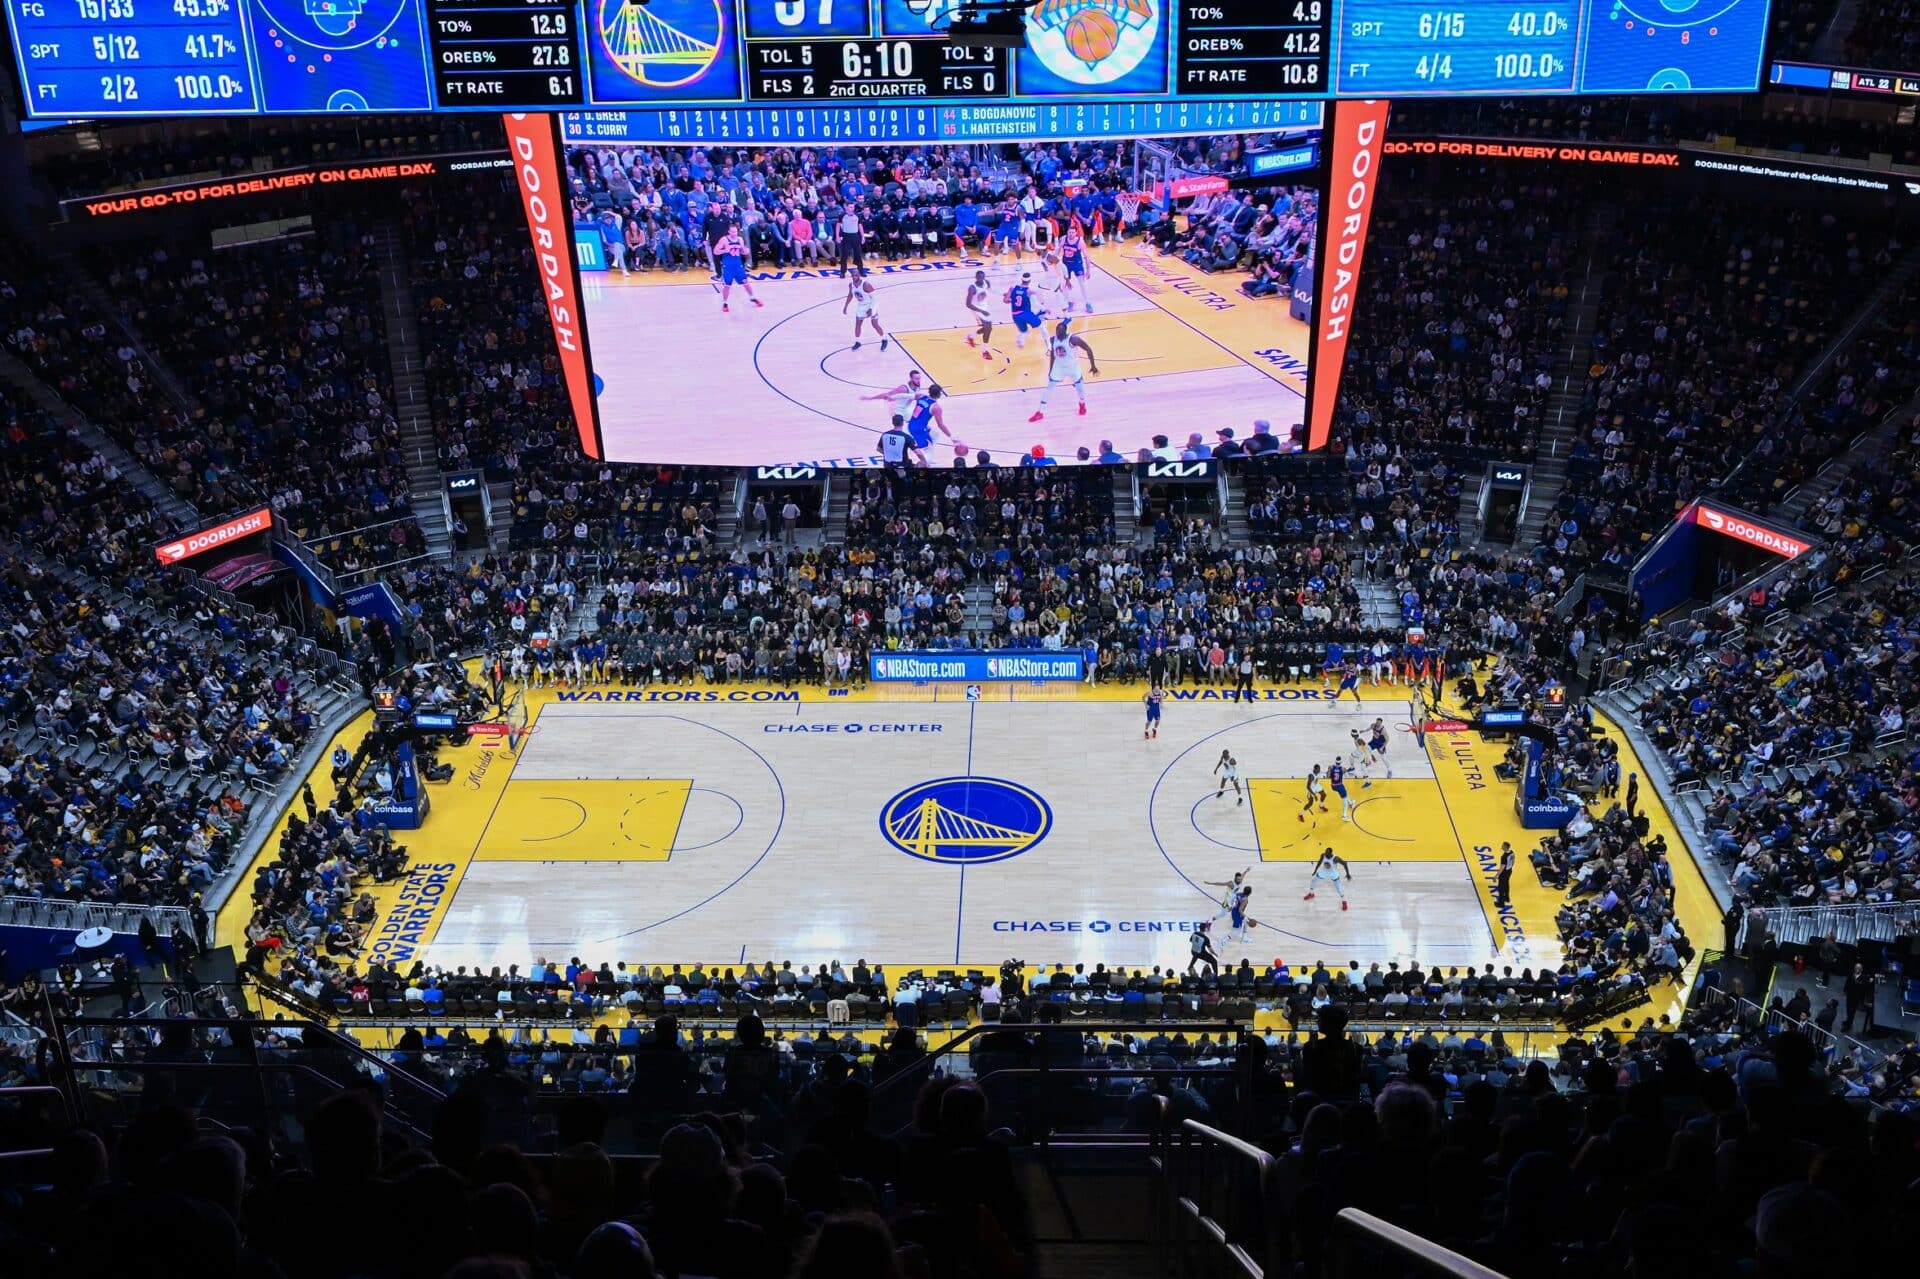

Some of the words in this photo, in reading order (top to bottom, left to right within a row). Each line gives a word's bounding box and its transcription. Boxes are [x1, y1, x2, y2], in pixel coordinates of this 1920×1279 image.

[22, 2, 45, 17] FG
[1189, 6, 1223, 20] TO%
[1293, 1, 1322, 22] 4.9
[438, 20, 472, 33] TO%
[531, 15, 567, 35] 12.9
[1351, 22, 1384, 37] 3PT
[1419, 12, 1465, 40] 6/15
[1507, 11, 1568, 37] 40.0%
[30, 43, 60, 58] 3PT
[93, 35, 140, 63] 5/12
[185, 35, 236, 58] 41.7%
[1188, 38, 1244, 52] OREB%
[1283, 34, 1321, 53] 41.2
[442, 51, 496, 65] OREB%
[532, 46, 570, 66] 27.8
[760, 50, 792, 64] TOL
[802, 46, 813, 65] 5
[843, 41, 913, 78] 6:10
[942, 46, 975, 61] TOL
[1349, 63, 1370, 78] FT
[1416, 54, 1452, 80] 4/4
[1494, 53, 1565, 78] 100.0%
[1187, 69, 1207, 82] FT
[1210, 69, 1247, 82] RATE
[1282, 65, 1318, 84] 10.8
[101, 75, 138, 102] 2/2
[174, 75, 243, 99] 100.0%
[446, 82, 463, 95] FT
[467, 81, 504, 95] RATE
[548, 76, 573, 97] 6.1
[763, 79, 792, 93] FLS
[803, 76, 814, 95] 2
[943, 76, 972, 90] FLS
[983, 73, 995, 92] 0
[1858, 78, 1875, 87] ATL
[1902, 82, 1919, 91] LAL
[38, 84, 58, 99] FT
[829, 85, 856, 97] 2nd
[859, 83, 927, 96] QUARTER
[918, 110, 925, 121] 0
[943, 109, 956, 120] 44
[961, 108, 971, 120] B.
[974, 107, 1036, 119] BOGDANOVIC
[1050, 106, 1057, 118] 8
[1077, 106, 1084, 117] 2
[1104, 105, 1109, 116] 1
[1130, 104, 1135, 115] 1
[1155, 103, 1162, 114] 0
[1300, 109, 1307, 121] 0
[596, 112, 626, 121] GREEN
[670, 111, 677, 122] 9
[695, 111, 702, 122] 2
[720, 111, 728, 122] 4
[746, 111, 751, 122] 1
[771, 111, 778, 122] 0
[797, 111, 804, 122] 0
[1156, 117, 1161, 128] 1
[1180, 115, 1187, 127] 0
[568, 125, 582, 135] 30
[586, 125, 596, 136] S.
[597, 125, 627, 136] CURRY
[669, 126, 680, 137] 10
[696, 126, 703, 137] 2
[722, 126, 729, 137] 2
[747, 126, 754, 137] 3
[772, 125, 779, 136] 0
[797, 125, 804, 136] 0
[918, 125, 925, 136] 0
[944, 123, 956, 135] 55
[962, 123, 968, 134] I.
[970, 121, 1036, 134] HARTENSTEIN
[1050, 121, 1057, 132] 8
[1076, 120, 1083, 131] 8
[1103, 119, 1109, 131] 5
[1130, 119, 1135, 130] 1
[1384, 141, 1436, 154] GO-TO
[1439, 143, 1473, 154] FOR
[1475, 144, 1557, 158] DELIVERY
[1559, 149, 1586, 159] ON
[1588, 150, 1639, 163] GAME
[1642, 154, 1680, 166] DAY.
[451, 161, 492, 171] DOORDASH
[1695, 160, 1738, 171] DOORDASH
[1739, 165, 1764, 174] Official
[1764, 168, 1790, 178] Partner
[1791, 171, 1799, 179] of
[1799, 173, 1811, 181] the
[1811, 174, 1837, 184] Golden
[1838, 177, 1857, 186] State
[1858, 179, 1889, 190] Warriors
[86, 196, 138, 216] YOUR
[140, 188, 197, 208] GO-TO
[200, 183, 235, 199] FOR
[237, 170, 318, 195] DELIVERY
[320, 167, 346, 183] ON
[348, 163, 398, 179] GAME
[400, 161, 436, 176] DAY.
[1326, 119, 1376, 341] DOORDASH
[515, 135, 576, 352] DOORDASH
[1015, 295, 1022, 307] 3
[1173, 281, 1236, 311] ULTRA
[1254, 348, 1306, 369] SAN
[189, 516, 261, 551] DOORDASH
[1727, 520, 1800, 557] DOORDASH
[888, 659, 966, 677] NBAStore.com
[999, 658, 1077, 677] NBAStore.com
[556, 690, 800, 702] WARRIORS.COM
[764, 724, 838, 733] CHASE
[869, 724, 943, 733] CENTER
[1455, 749, 1486, 790] ULTRA
[374, 805, 413, 814] coinbase
[1528, 804, 1569, 813] coinbase
[1474, 846, 1499, 871] SAN
[367, 904, 411, 965] GOLDEN
[399, 863, 432, 899] STATE
[386, 862, 457, 964] WARRIORS
[993, 921, 1082, 932] CHASE
